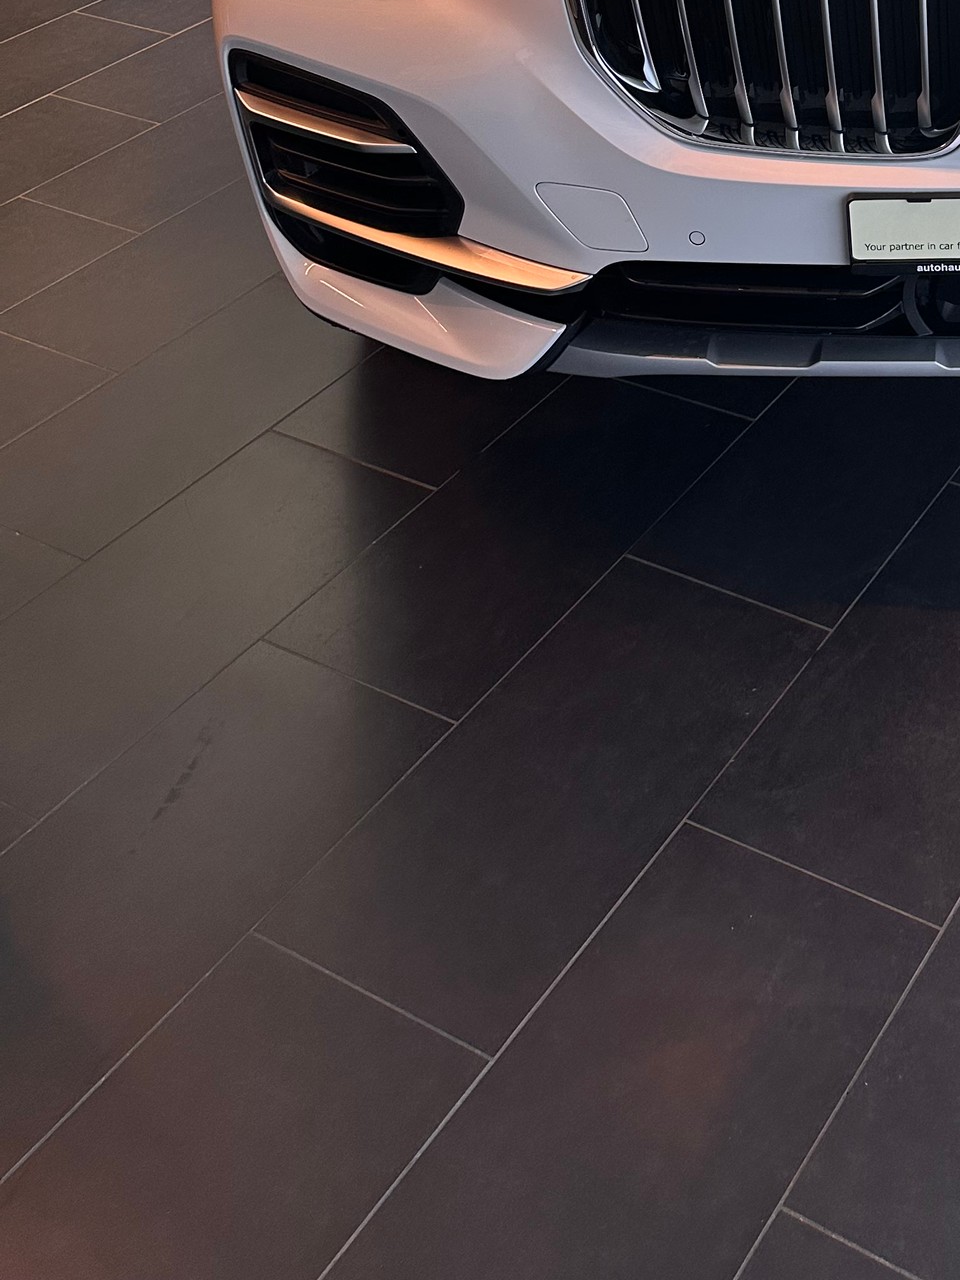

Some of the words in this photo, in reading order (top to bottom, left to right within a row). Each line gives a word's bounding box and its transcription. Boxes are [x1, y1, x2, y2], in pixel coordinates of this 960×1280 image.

[864, 243, 886, 251] Your
[890, 243, 924, 252] partner
[927, 242, 936, 250] in
